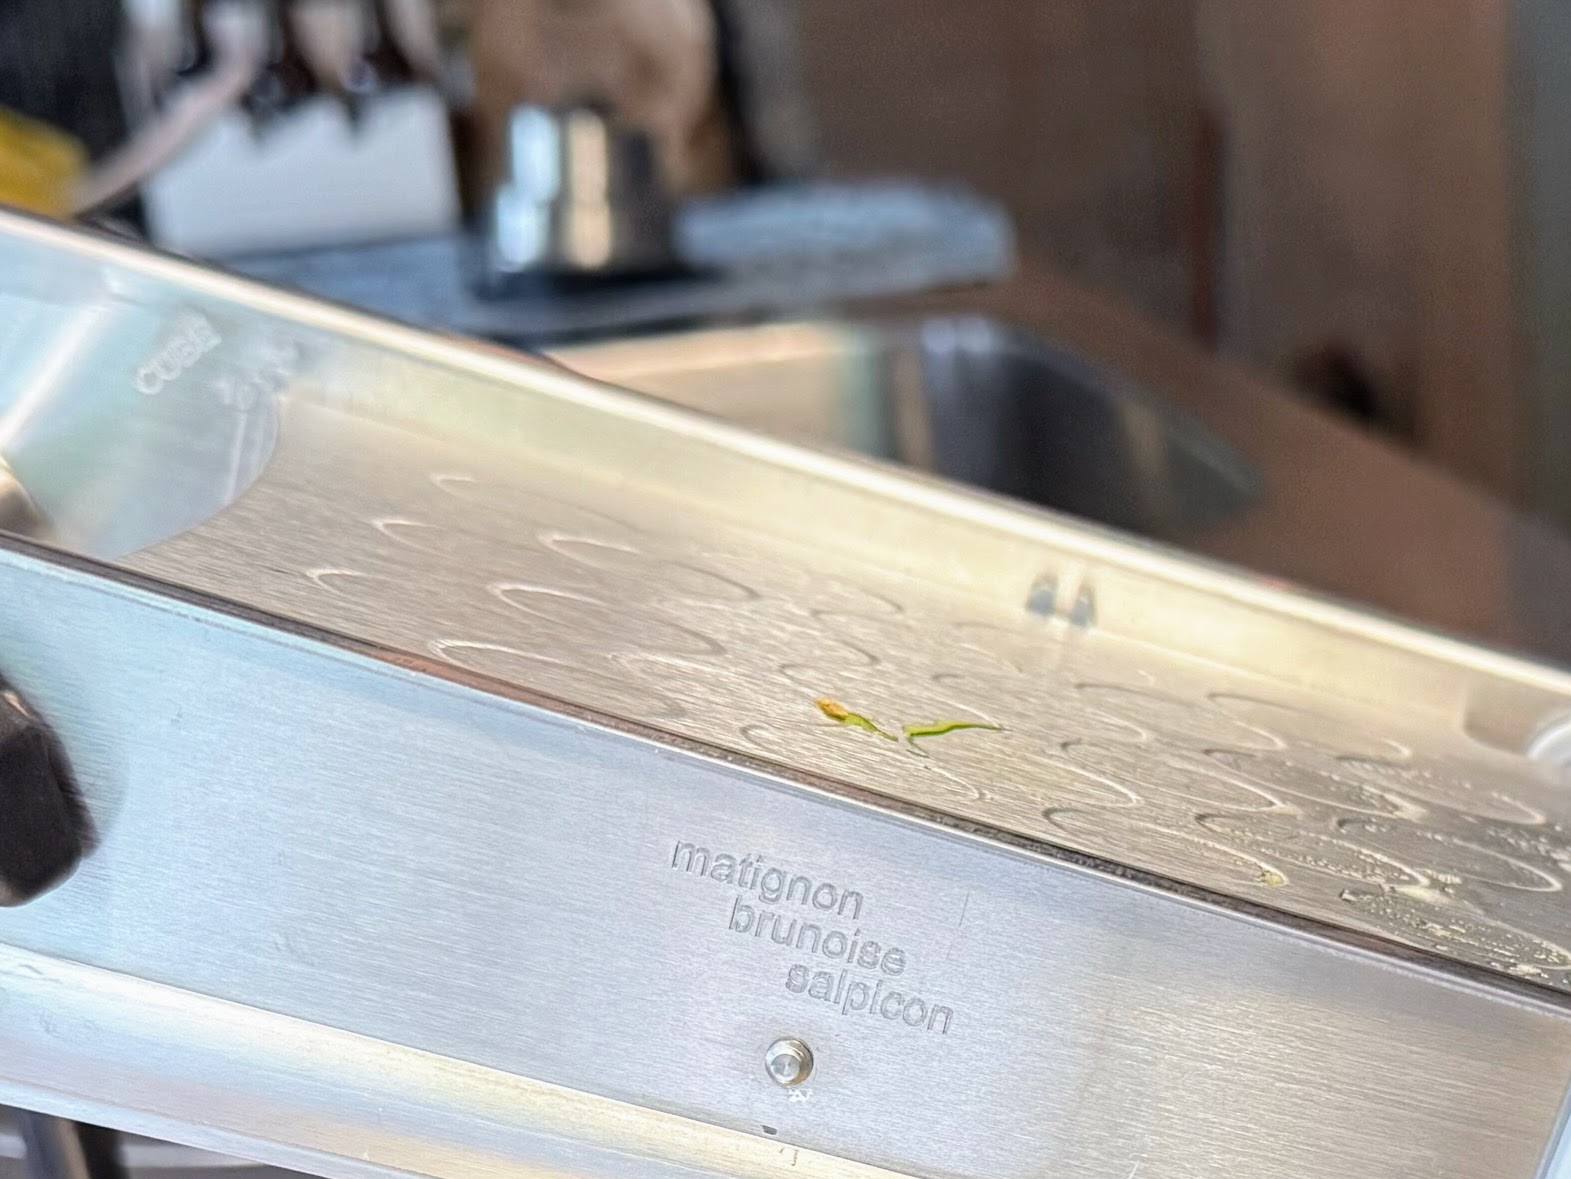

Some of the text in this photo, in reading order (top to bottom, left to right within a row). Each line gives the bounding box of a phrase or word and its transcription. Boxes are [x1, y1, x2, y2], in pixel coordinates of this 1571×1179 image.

[672, 840, 864, 919] matignon
[729, 896, 906, 974] brunoise
[786, 964, 953, 1035] salpicon
